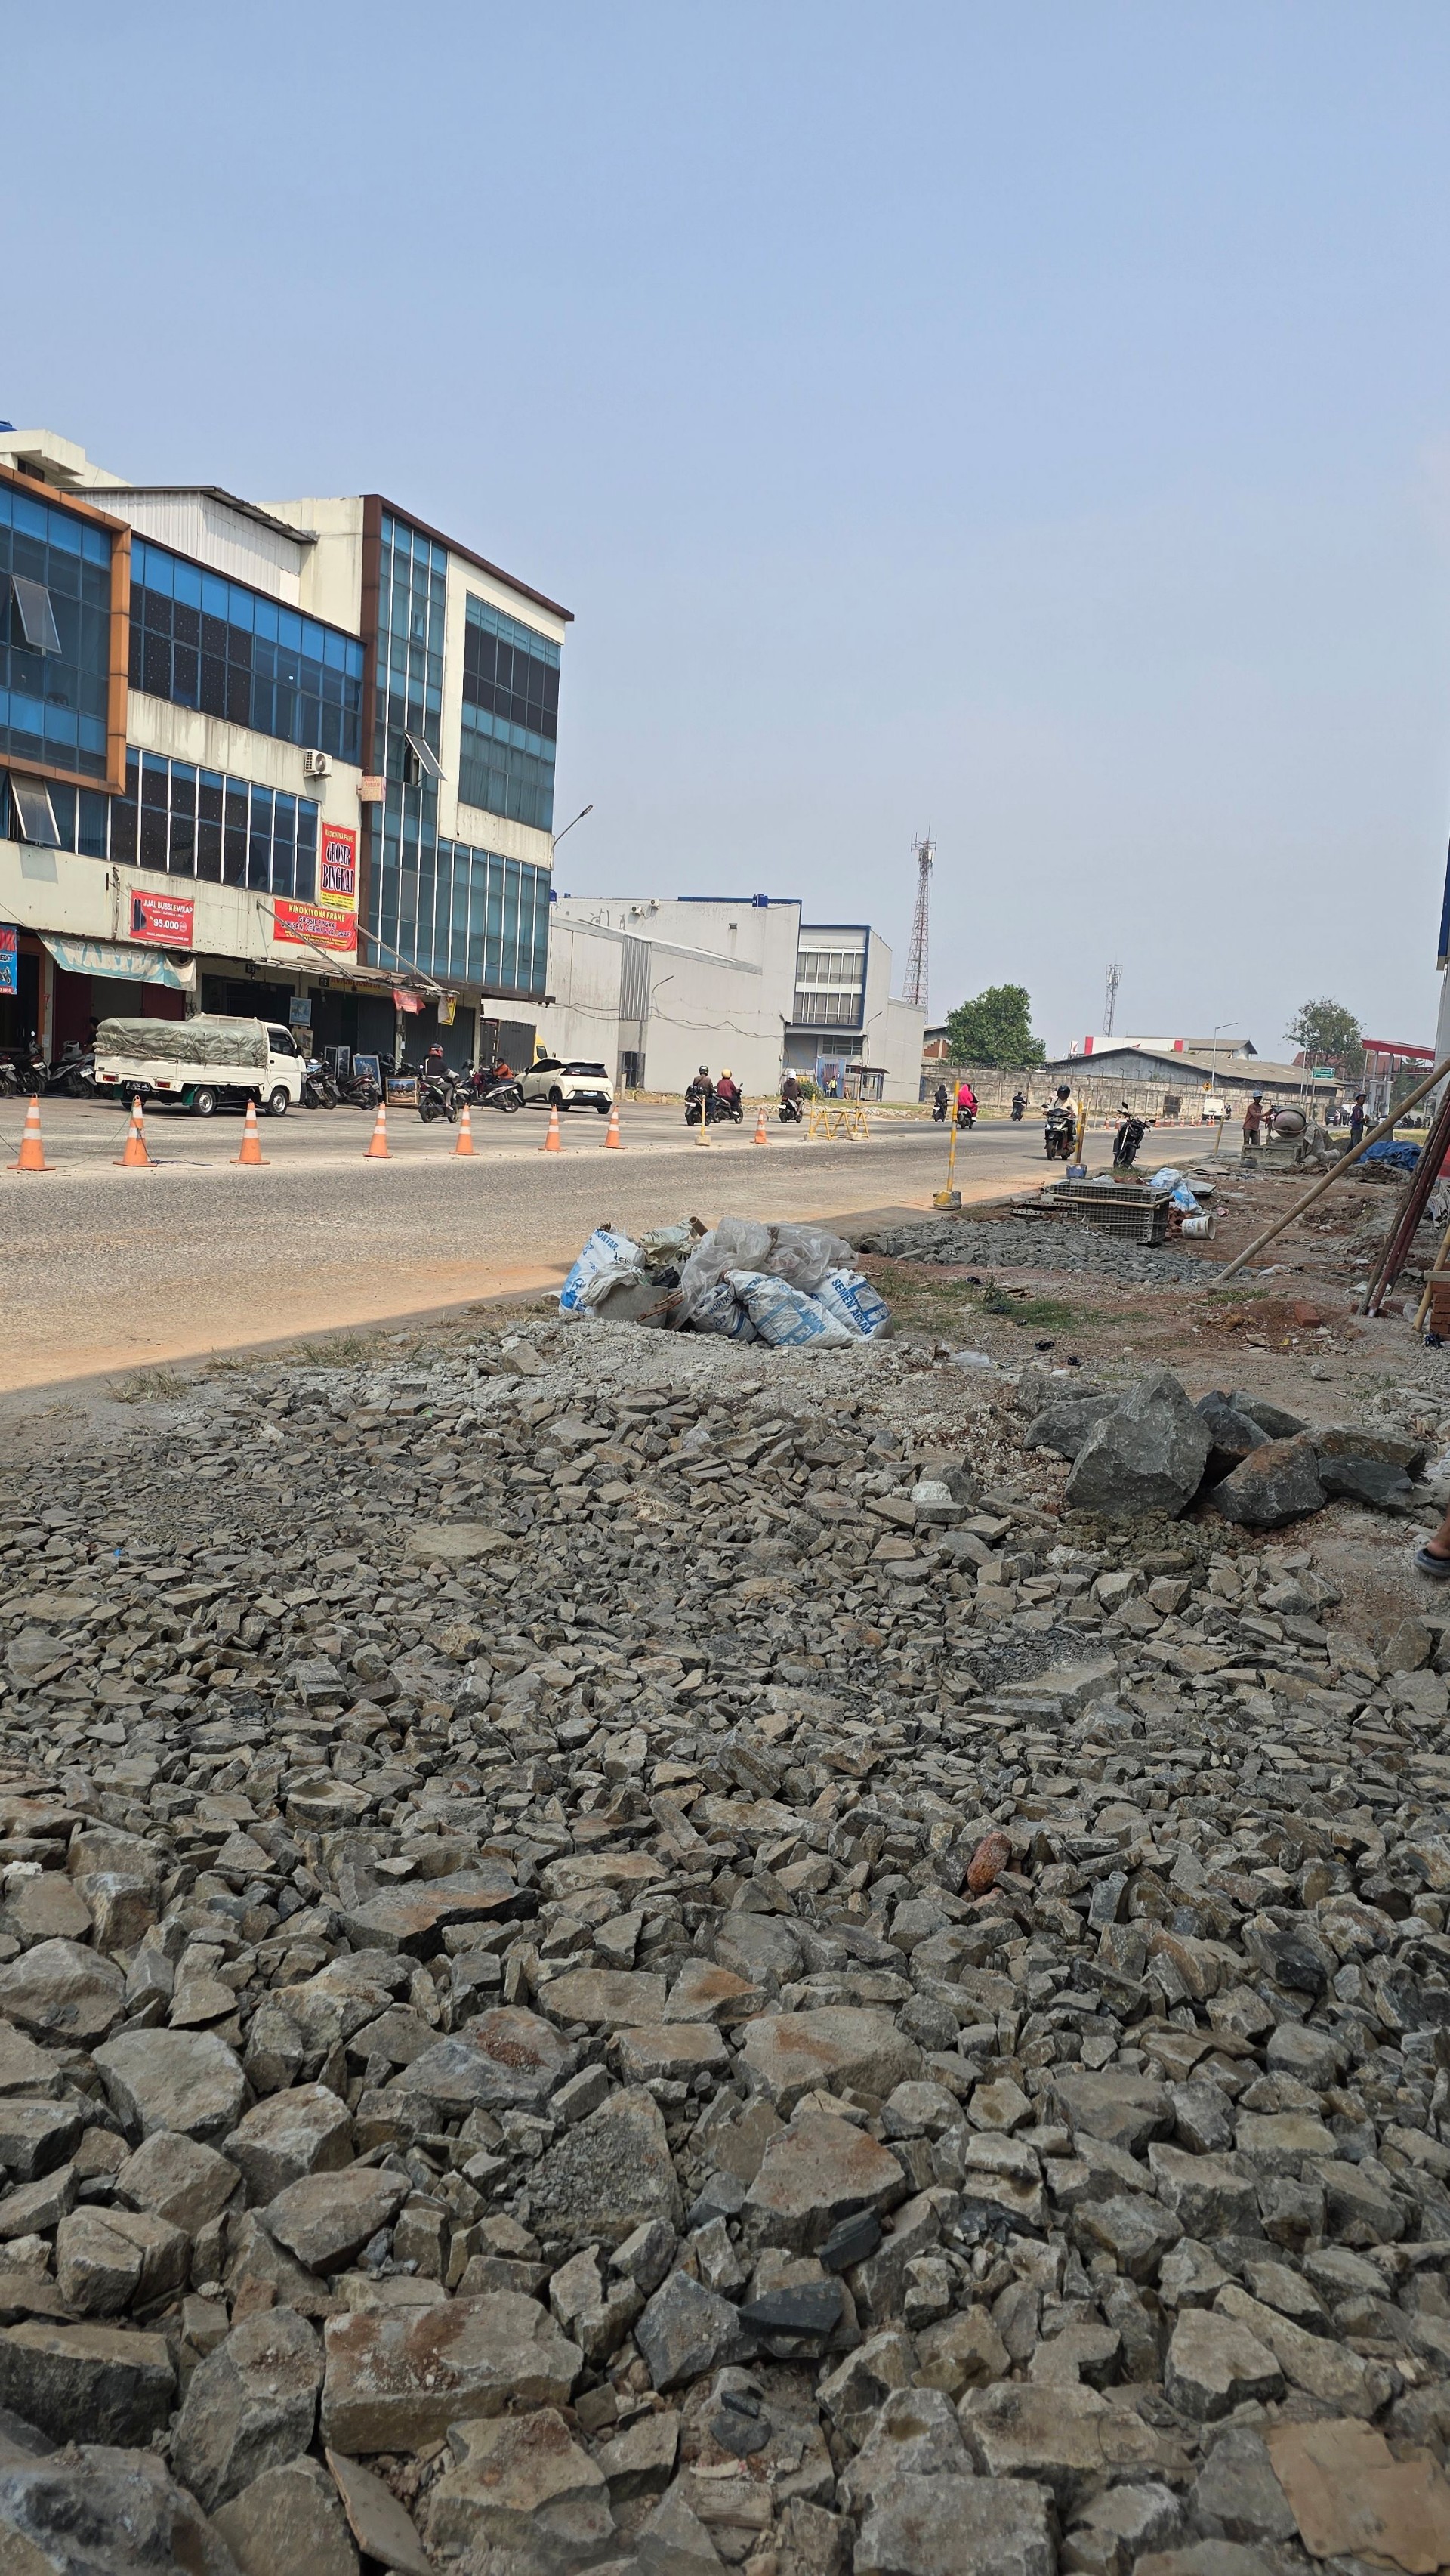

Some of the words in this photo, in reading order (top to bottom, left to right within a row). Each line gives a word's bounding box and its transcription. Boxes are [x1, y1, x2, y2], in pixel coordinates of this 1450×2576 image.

[326, 842, 351, 866] GROSIR
[322, 863, 354, 894] BINGKAI
[143, 899, 156, 908] JUAL
[158, 901, 177, 911] BUBBLE
[289, 904, 304, 914] KIKO
[326, 912, 345, 922] FRAME
[153, 918, 179, 929] 95.000
[708, 1292, 733, 1315] MORTAR
[831, 1278, 856, 1309] SEMEN
[850, 1308, 874, 1335] ACIAN
